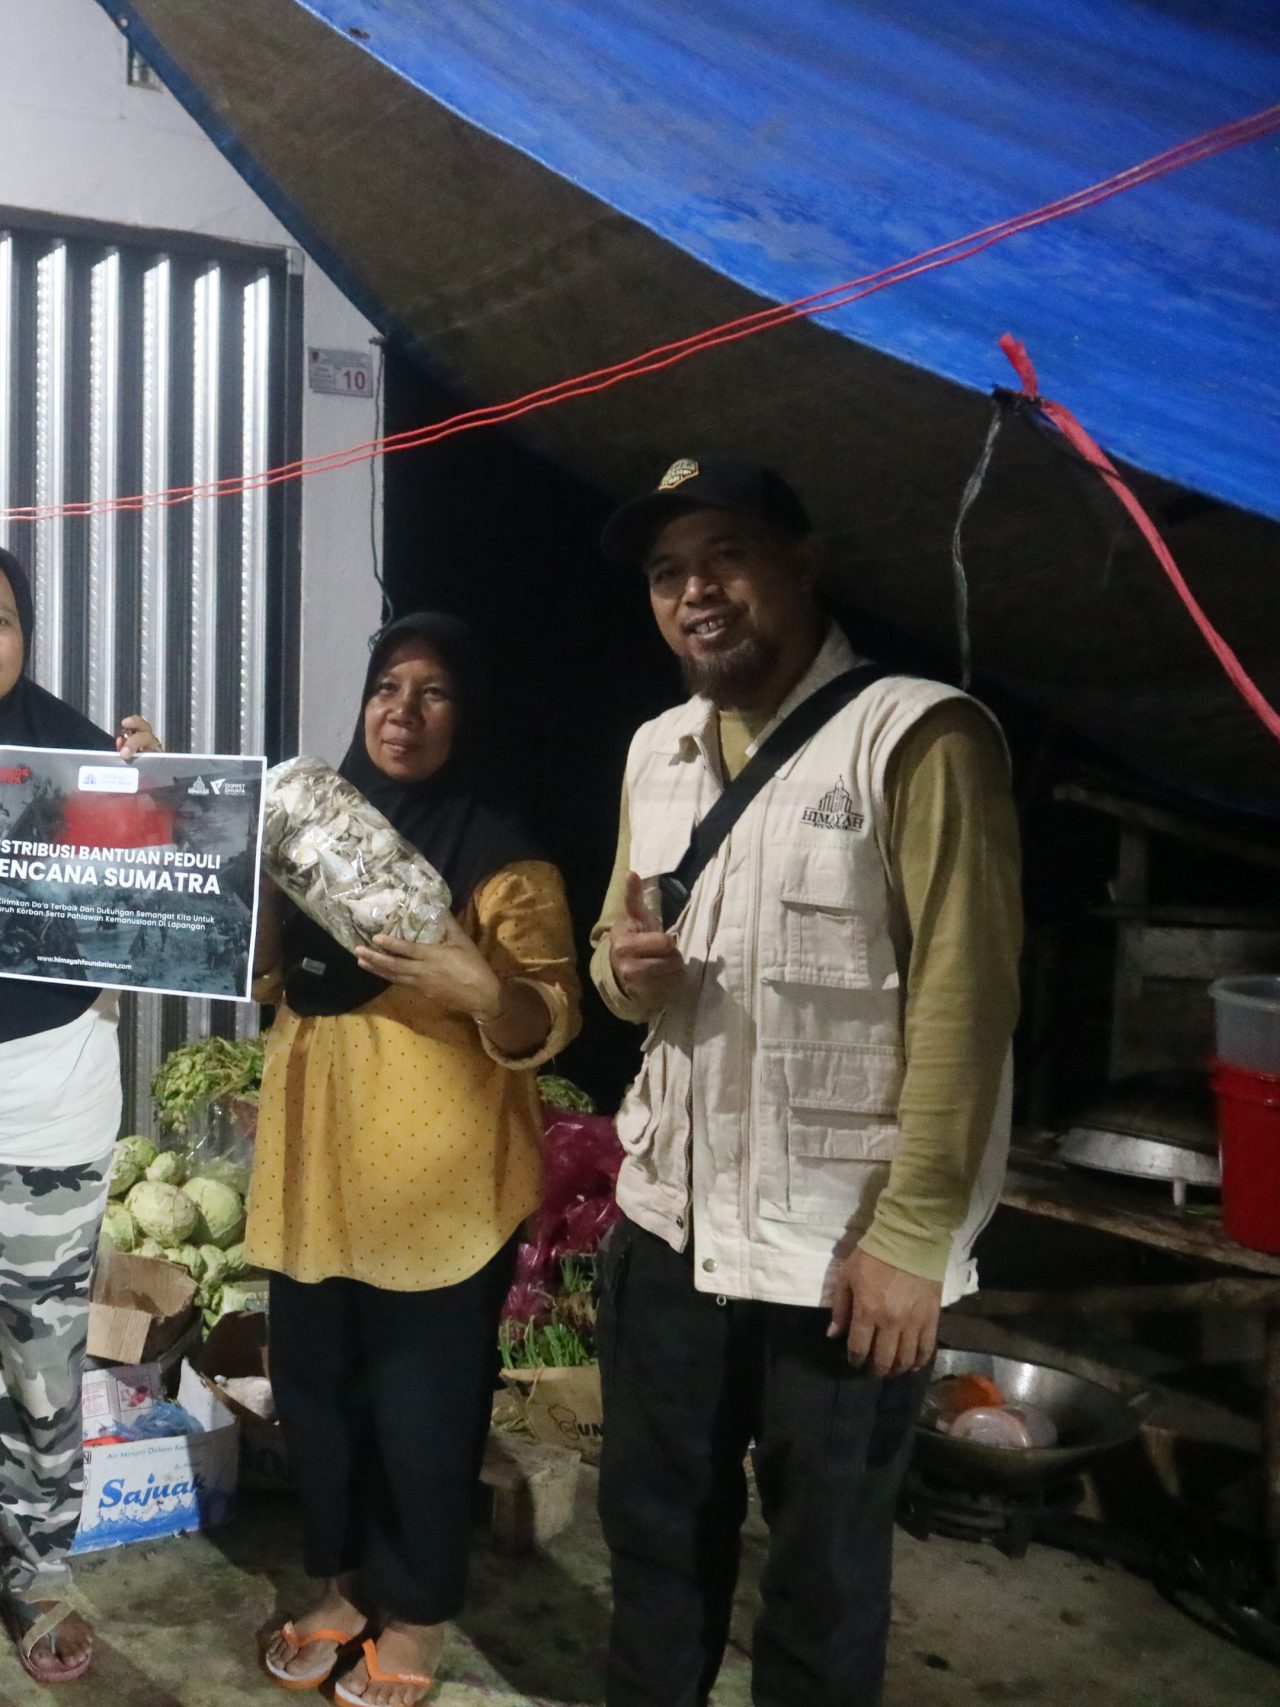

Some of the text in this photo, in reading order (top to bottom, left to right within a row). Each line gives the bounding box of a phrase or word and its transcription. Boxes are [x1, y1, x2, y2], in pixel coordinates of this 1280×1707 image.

[343, 370, 366, 391] 10
[79, 845, 160, 865] BANTUAN
[163, 851, 221, 869] PEDULI
[104, 867, 221, 894] SUMATRA
[16, 906, 44, 917] Korban
[45, 910, 66, 919] Serta
[66, 912, 103, 923] Pahlawan
[105, 915, 157, 927] Kemanusiaan
[158, 920, 167, 928] Di
[168, 921, 206, 931] Lapangan
[51, 903, 78, 912] Terbaik
[80, 905, 95, 914] Dan
[96, 907, 135, 918] Dukungan
[136, 910, 175, 921] Semangat
[176, 913, 192, 922] Kita
[193, 915, 215, 924] Untuk
